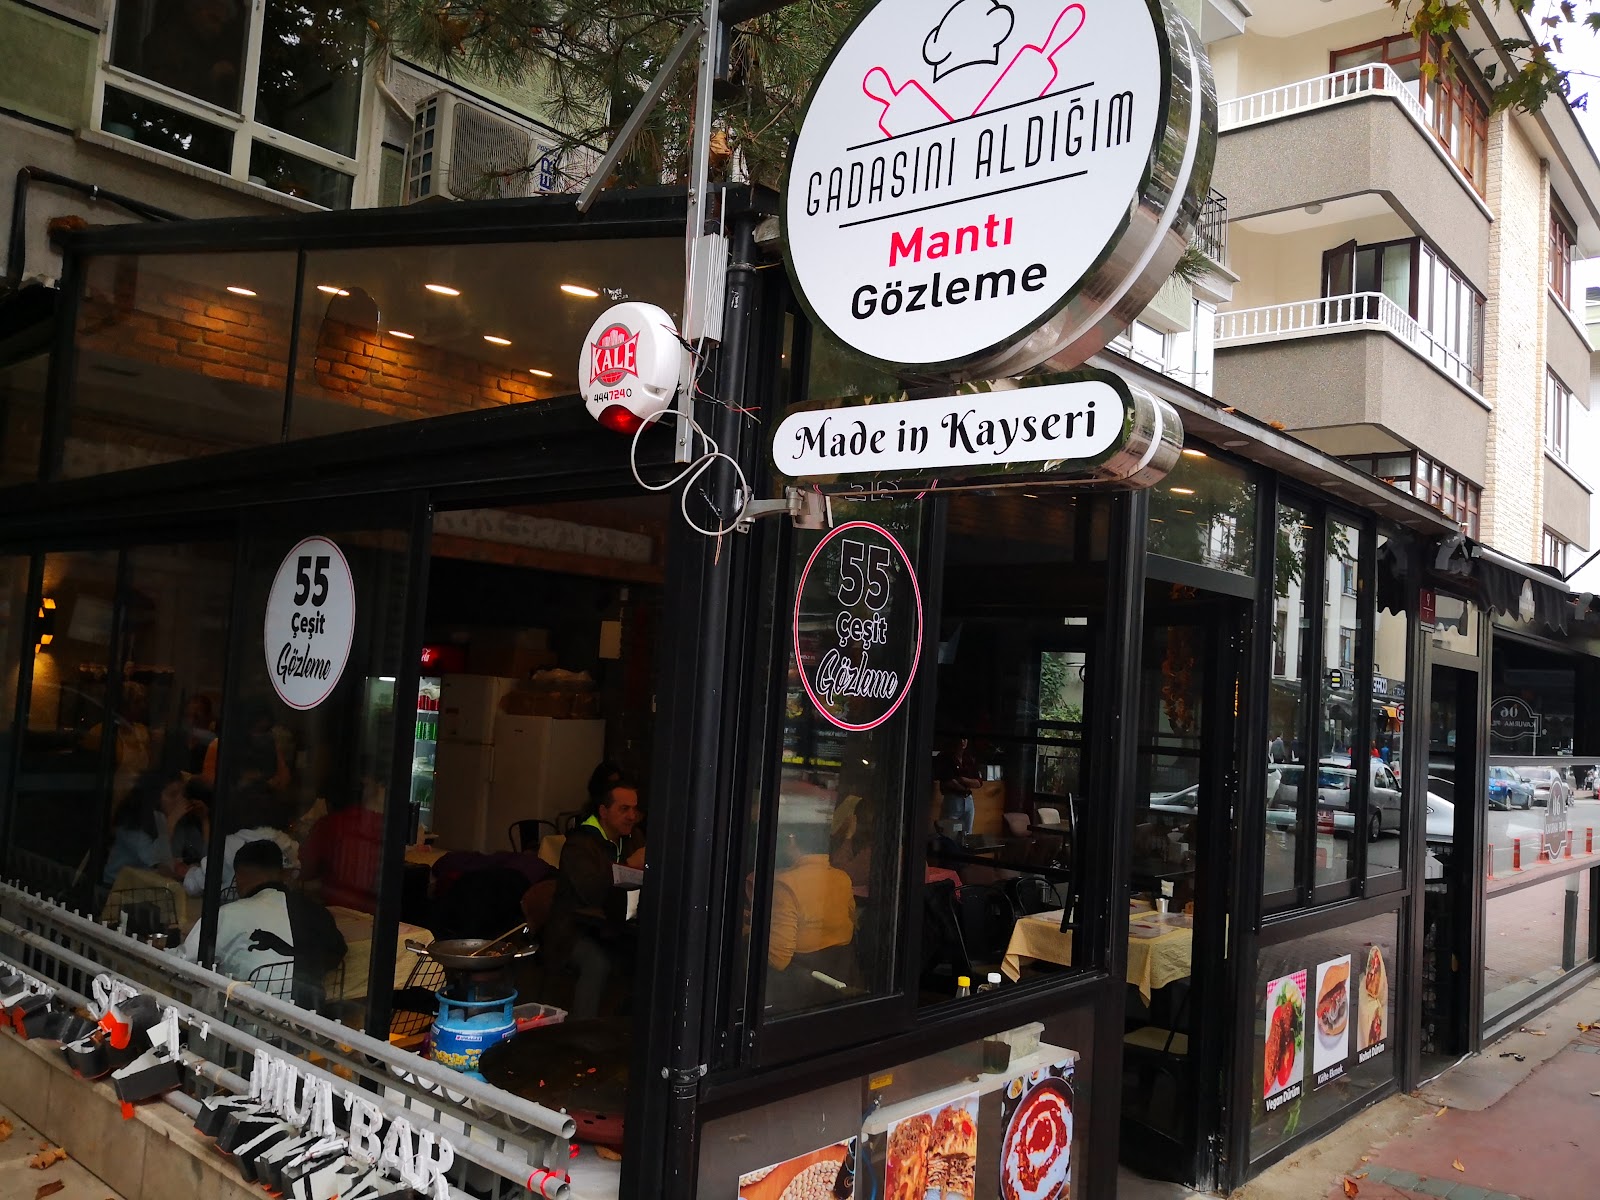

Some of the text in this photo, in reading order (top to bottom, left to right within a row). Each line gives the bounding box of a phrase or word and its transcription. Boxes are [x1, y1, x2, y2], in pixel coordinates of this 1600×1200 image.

[806, 91, 1134, 216] GADASINI ALDIĞIM
[889, 213, 1014, 267] Mantı
[851, 262, 1047, 320] Gözleme
[591, 337, 637, 381] KALE
[792, 401, 1096, 460] Made in Kayseri
[294, 556, 330, 607] 55
[838, 539, 890, 610] 55
[291, 610, 325, 639] Çeşit
[836, 611, 888, 649] Çeşit
[276, 642, 331, 684] Gözleme
[816, 649, 898, 706] Gözleme
[1266, 1085, 1300, 1111] Vegan Dürüm
